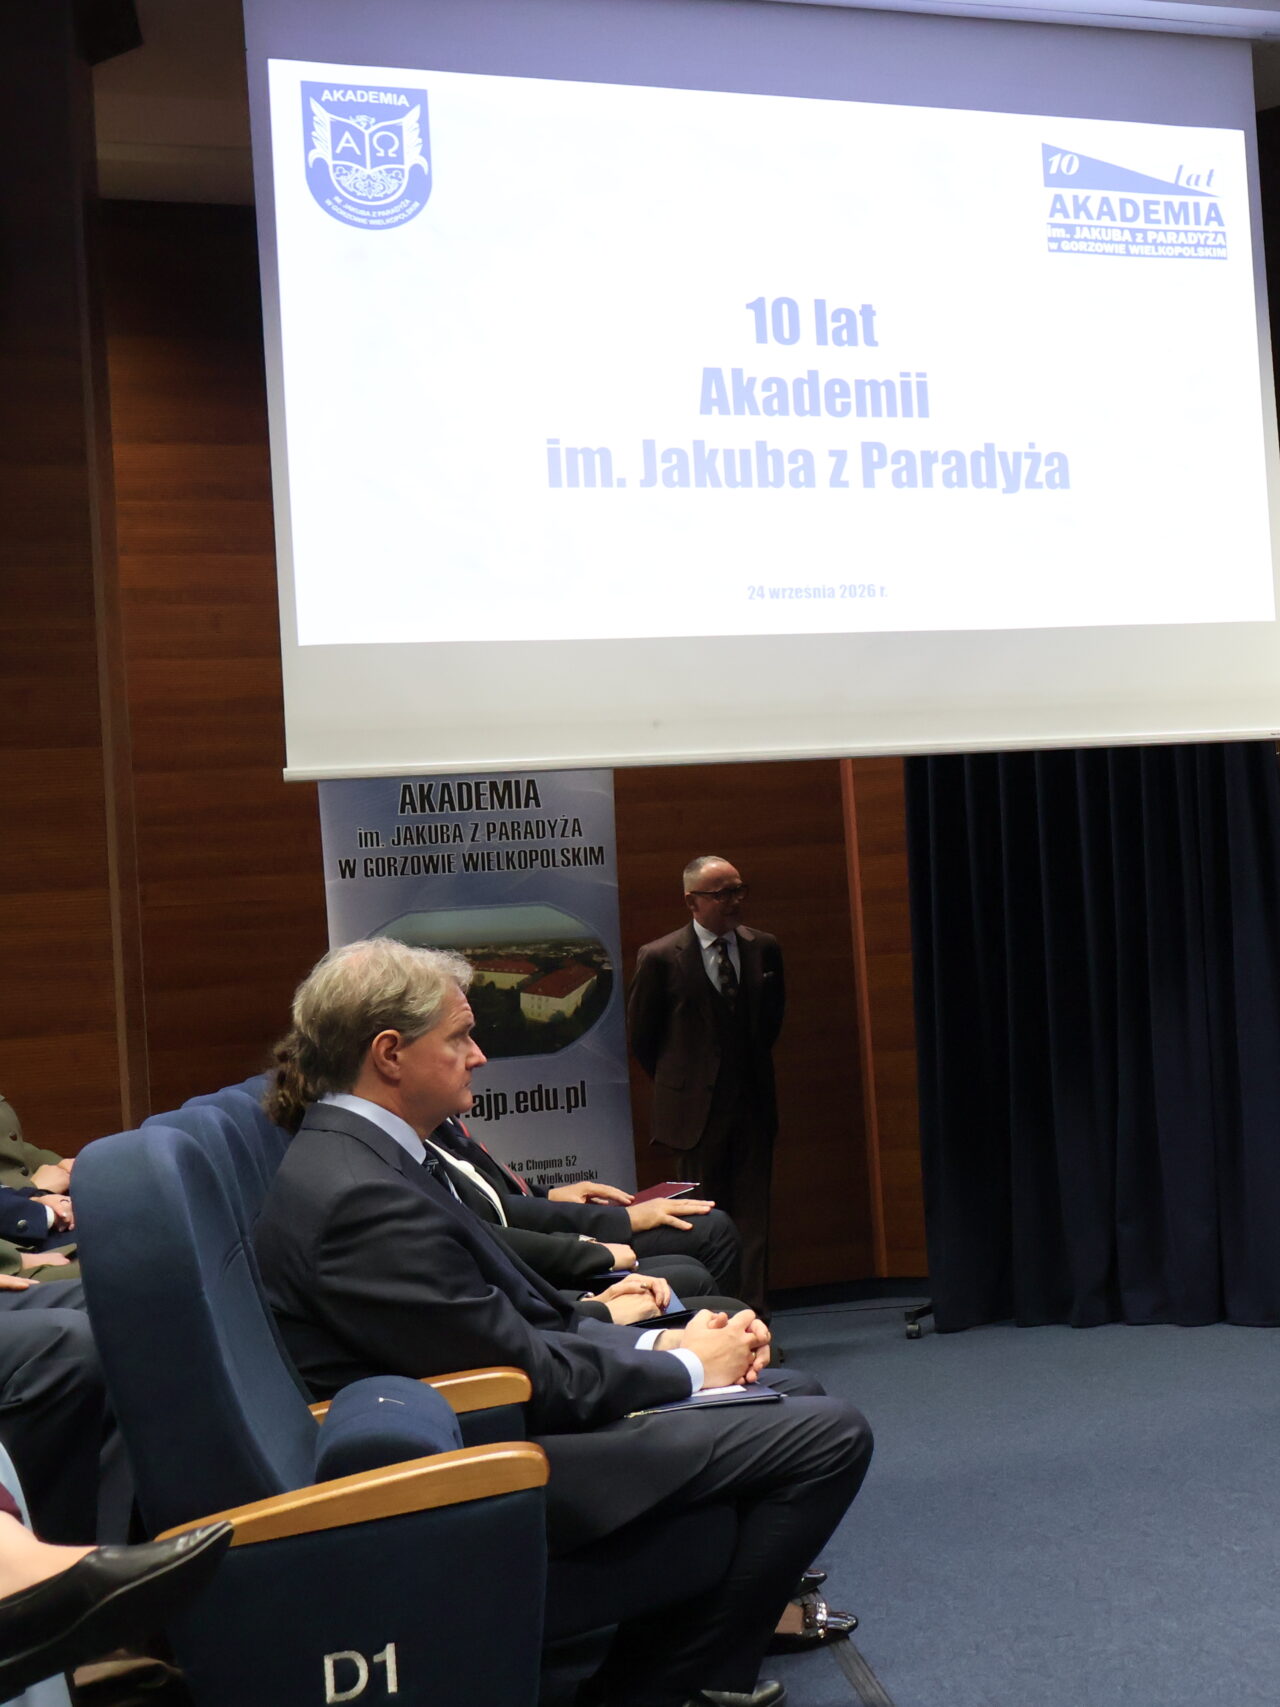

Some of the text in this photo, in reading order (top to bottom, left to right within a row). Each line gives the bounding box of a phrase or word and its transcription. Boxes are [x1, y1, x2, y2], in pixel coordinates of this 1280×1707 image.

[321, 89, 410, 107] AKADEMIA
[1048, 153, 1214, 187] 10 lat
[1049, 193, 1225, 227] AKADEMIA
[1047, 224, 1070, 238] im.
[1073, 226, 1133, 243] JAKUBA
[1146, 229, 1226, 246] PARADYŻA
[1061, 240, 1126, 254] GORZOWIE
[1128, 244, 1227, 258] WIELKOPOLSKIM
[745, 296, 879, 347] 10 lat
[699, 366, 930, 418] Akademii
[546, 438, 1071, 494] im. Jakuba z Paradyża
[747, 584, 888, 600] 24 września 2026 r.
[399, 779, 542, 815] AKADEMIA
[358, 815, 583, 848] im. JAKUBA Z PARADYŻA
[338, 846, 605, 879] W GORZOWIE WIELKOPOLSKIM
[457, 1080, 586, 1121] .ajp.edu.pl
[566, 1155, 577, 1167] 52
[324, 1642, 398, 1704] D1
